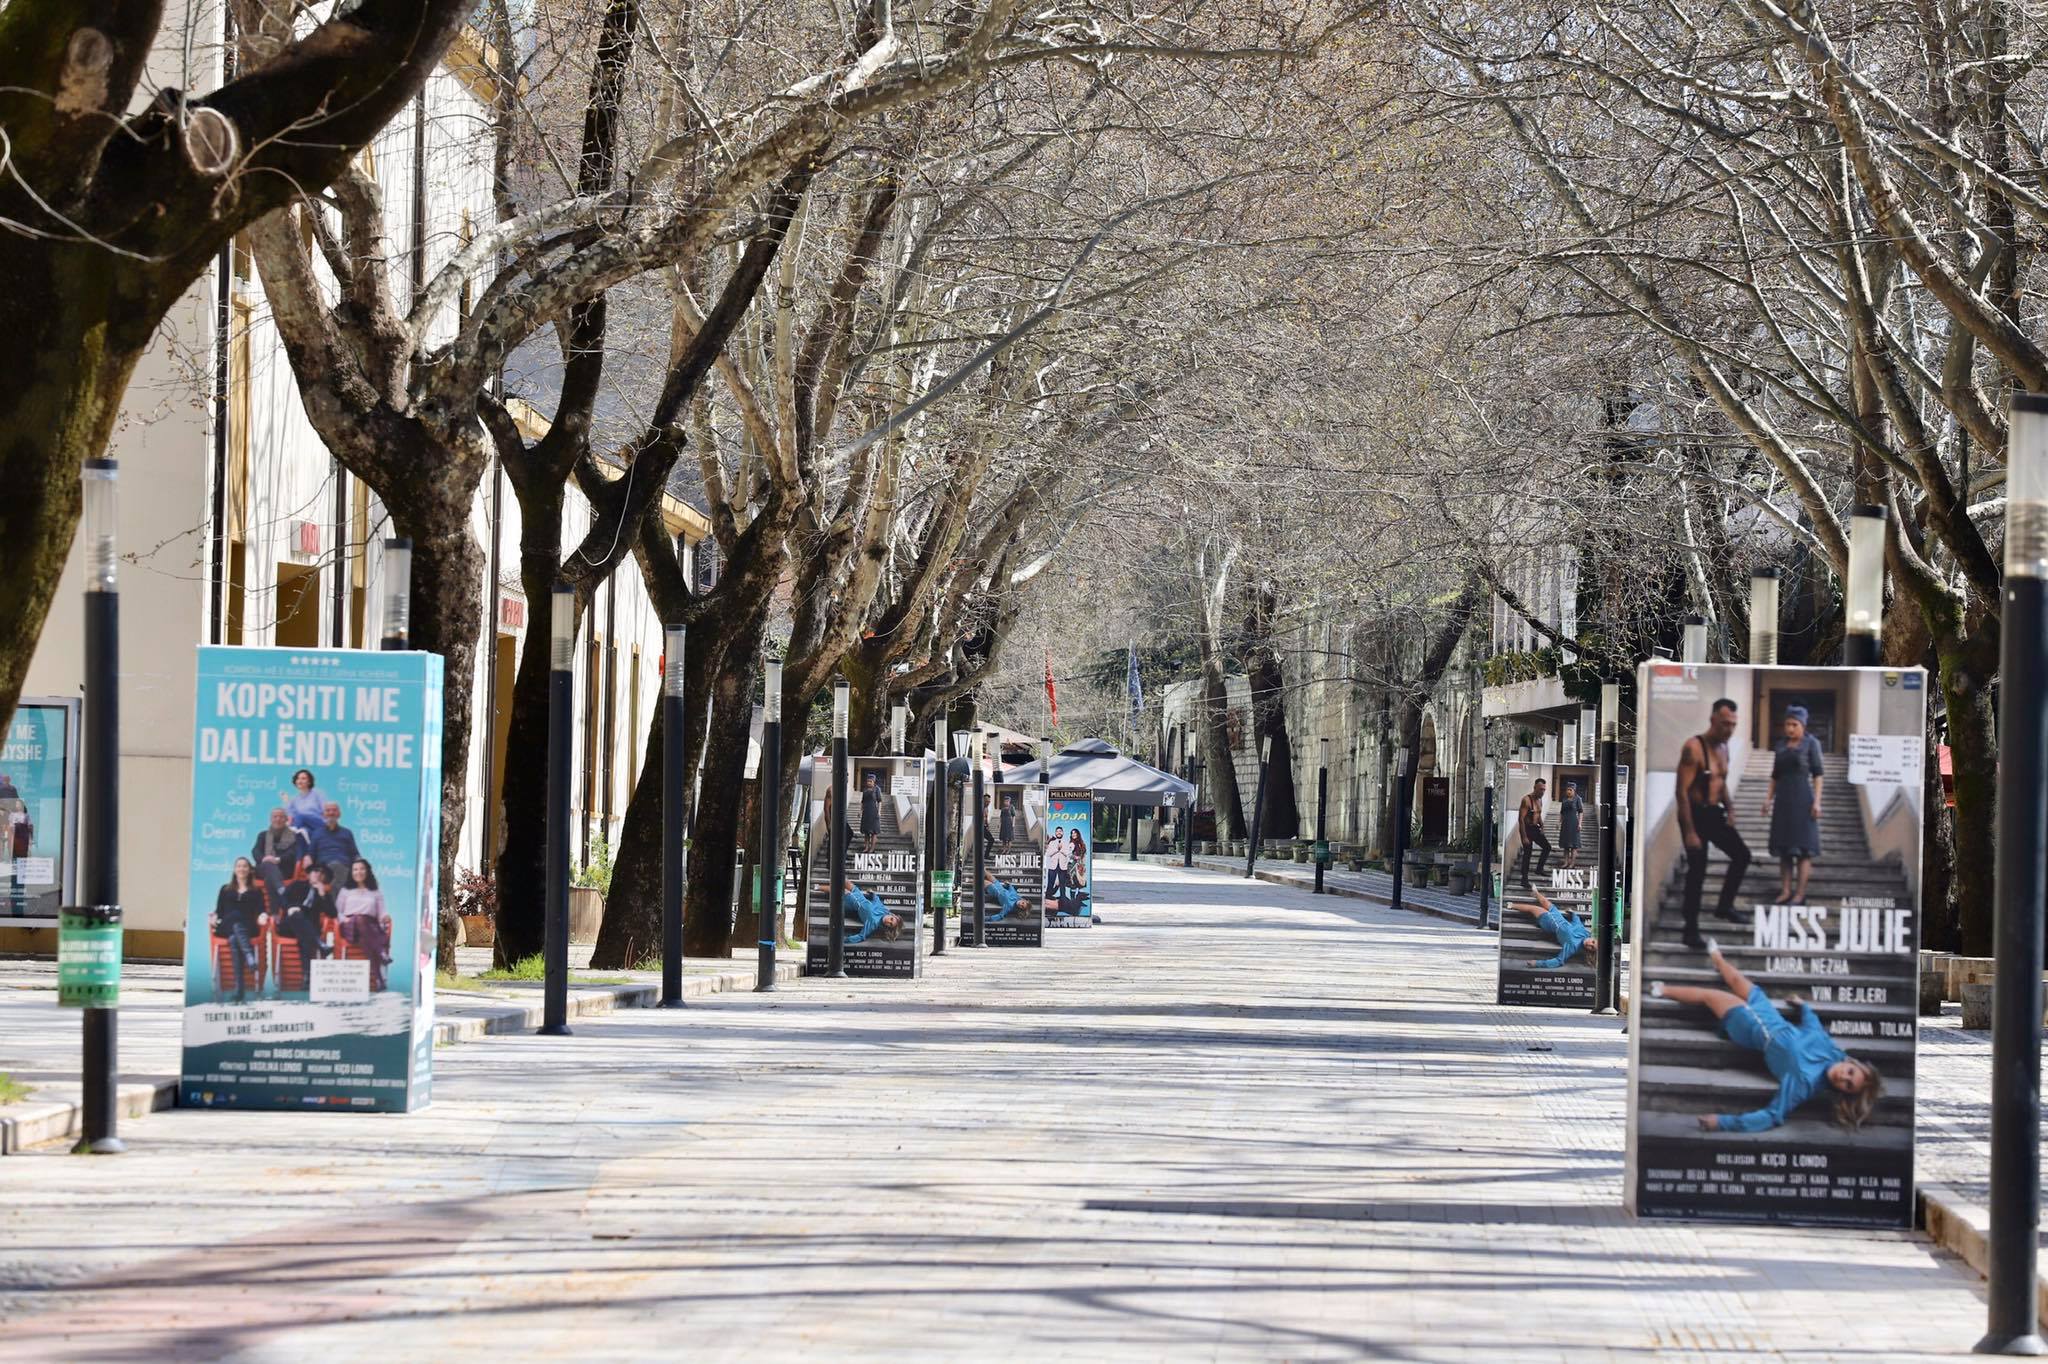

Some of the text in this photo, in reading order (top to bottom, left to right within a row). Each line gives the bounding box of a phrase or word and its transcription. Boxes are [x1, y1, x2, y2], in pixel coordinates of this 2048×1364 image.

[216, 682, 401, 722] KOPSHTI ME
[200, 723, 414, 769] DALLËNDYSHE
[855, 853, 883, 871] MISS
[886, 854, 916, 872] JULIE
[995, 855, 1041, 868] MISS JULIE
[1552, 869, 1583, 889] MISS
[1754, 905, 1912, 953] MISS JULIE
[1766, 957, 1849, 975] LAURA NEZHA
[1811, 986, 1887, 1003] VIN BEJLERI
[205, 1012, 232, 1023] TEATRI
[1830, 1020, 1913, 1036] ADRIANA TOLKA
[1792, 1155, 1827, 1168] LONDO
